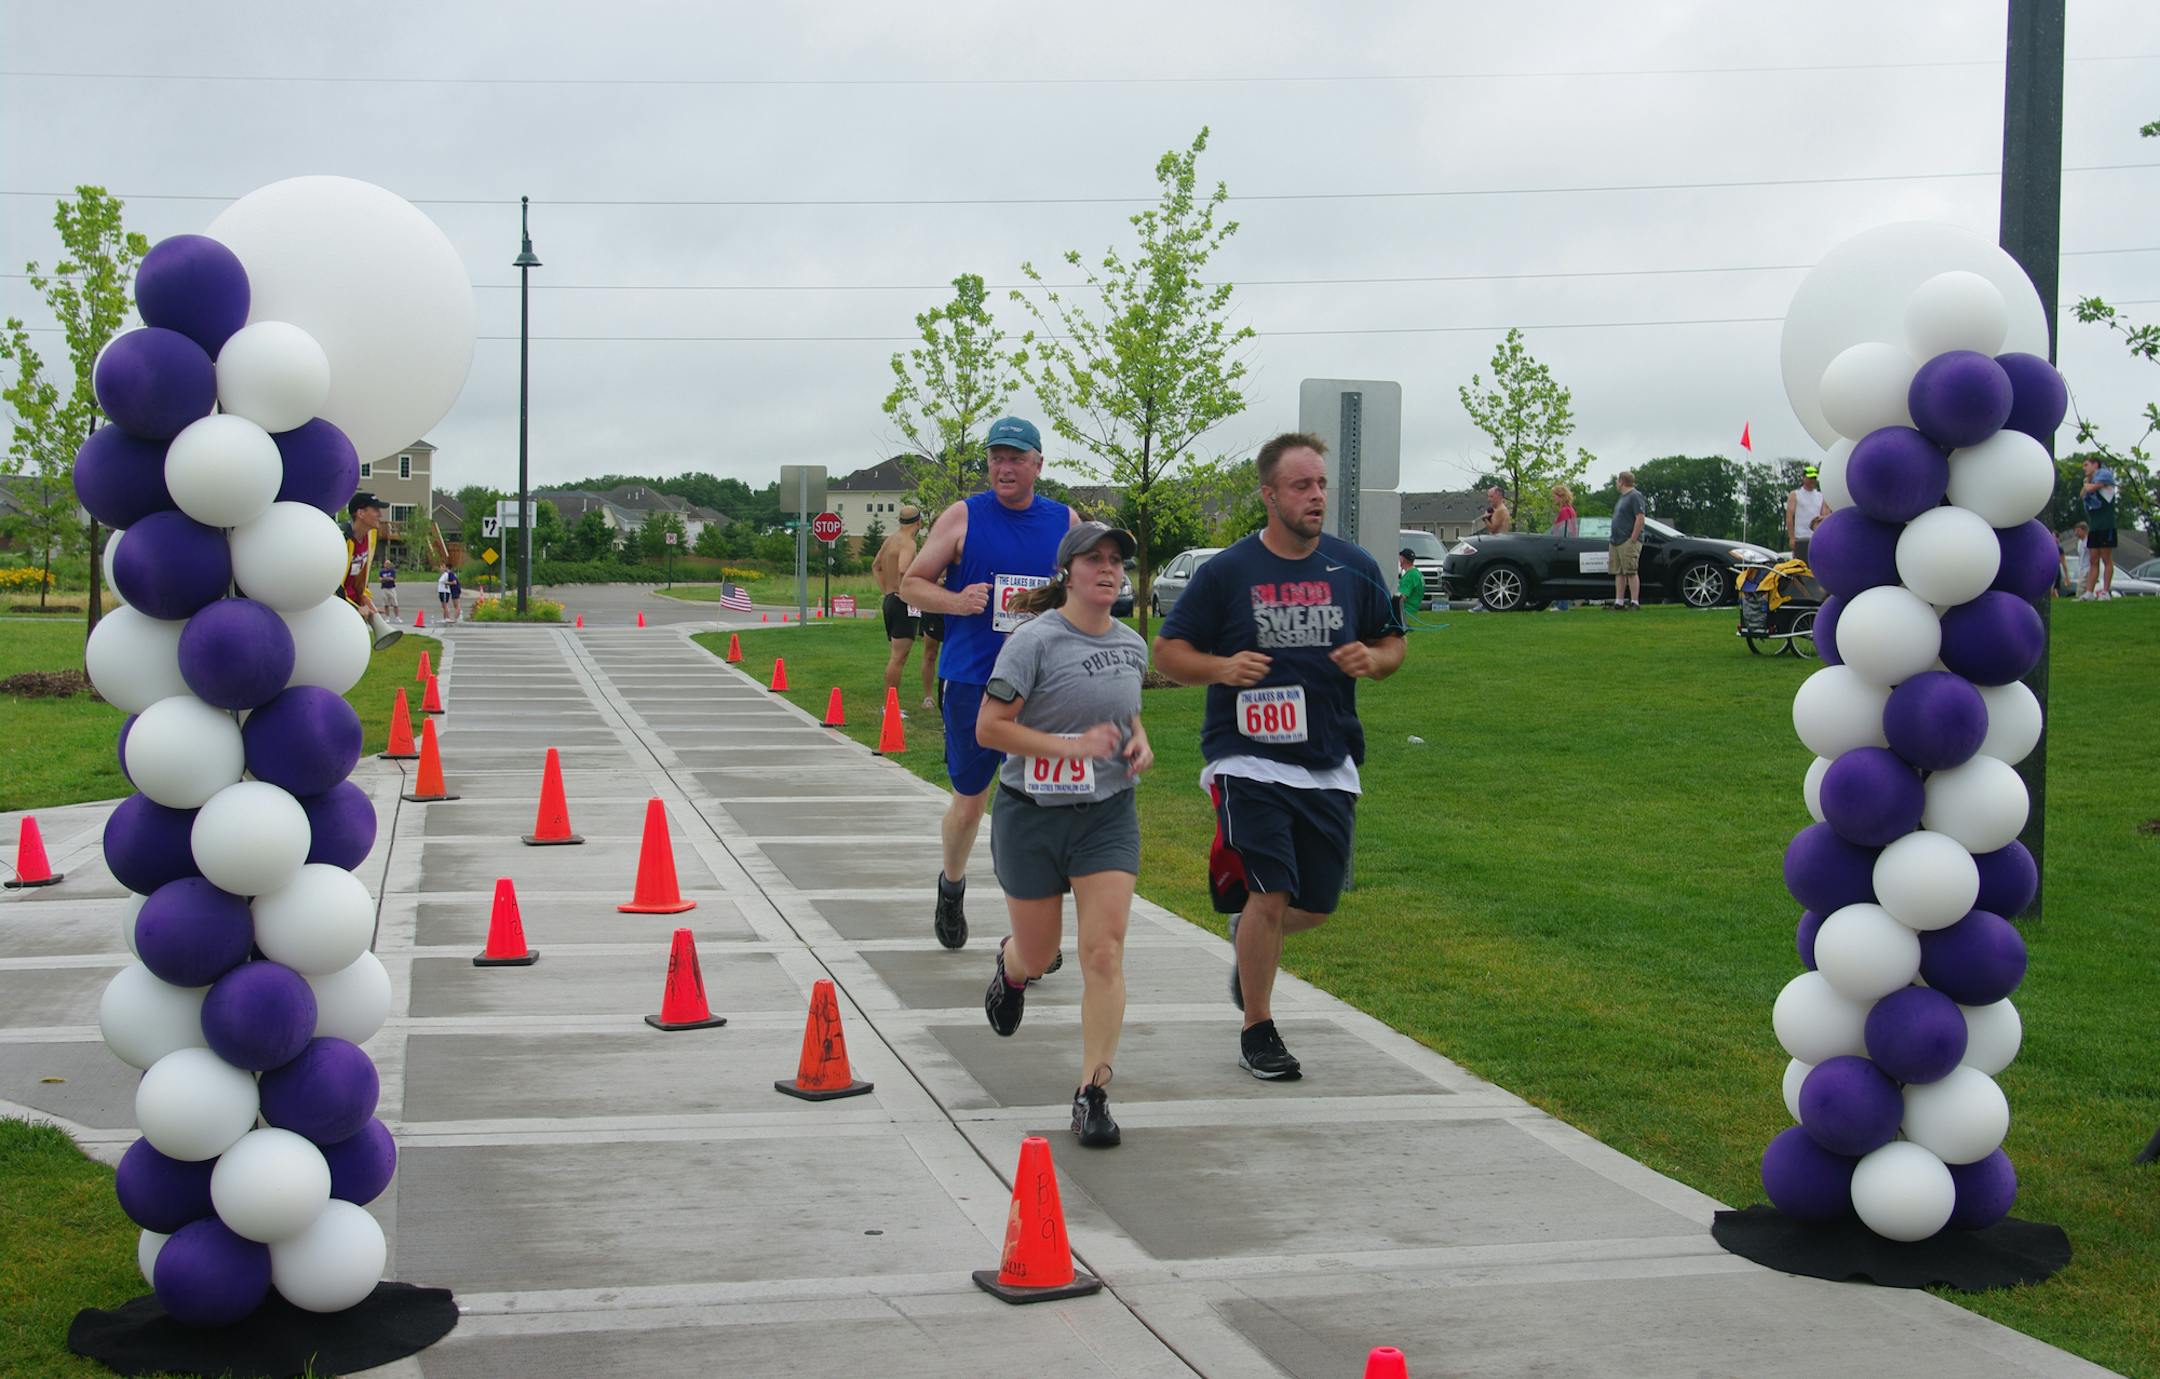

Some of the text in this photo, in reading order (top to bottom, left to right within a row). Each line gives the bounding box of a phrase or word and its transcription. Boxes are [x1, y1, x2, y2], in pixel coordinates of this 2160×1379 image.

[815, 521, 840, 533] STOP
[999, 576, 1009, 586] THE
[1010, 577, 1028, 587] LAKES
[1251, 581, 1332, 609] BLOOD
[1257, 628, 1332, 648] BASEBALL
[1081, 649, 1124, 677] PHYS.
[1241, 693, 1252, 704] THE
[1253, 691, 1276, 703] LAKES
[1286, 689, 1300, 700] RUN
[1246, 701, 1297, 734] 680
[1033, 755, 1086, 783] 679
